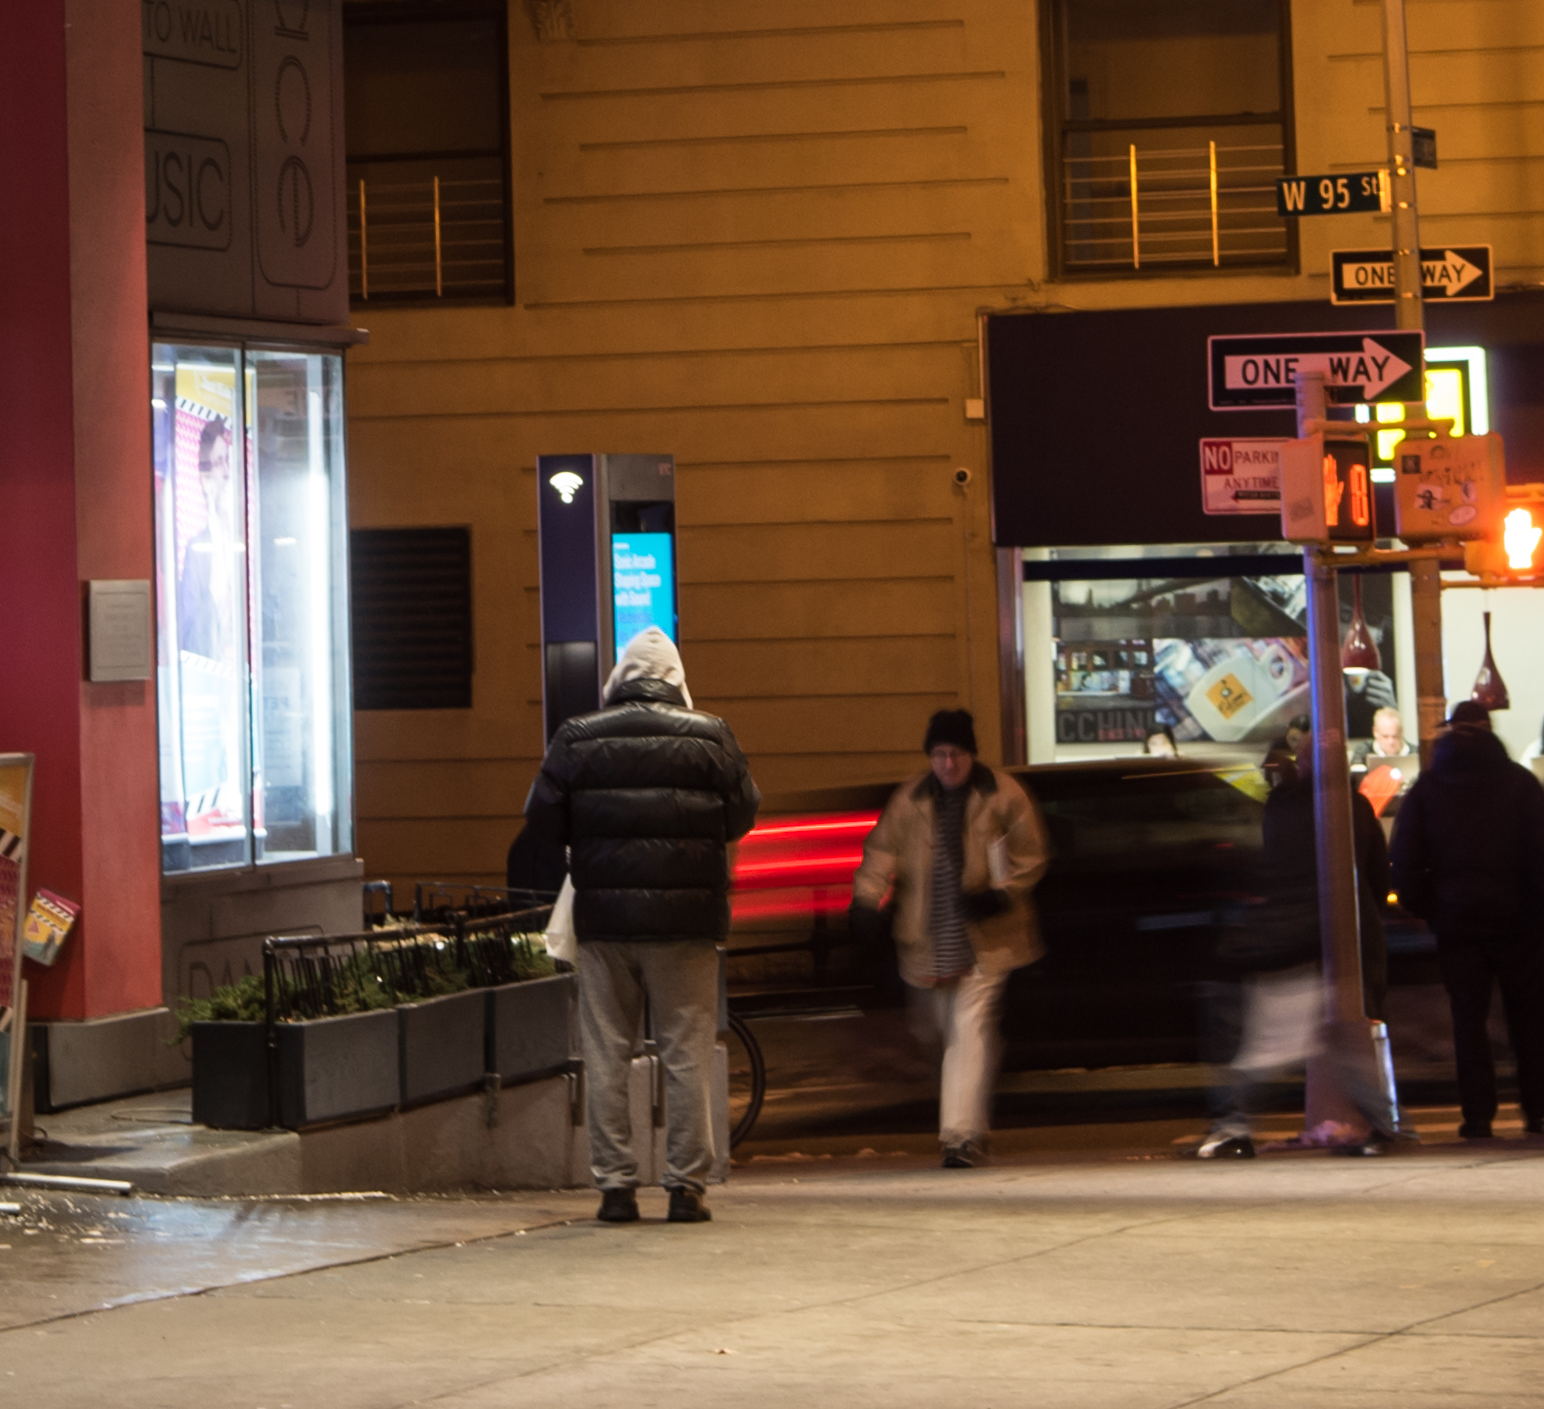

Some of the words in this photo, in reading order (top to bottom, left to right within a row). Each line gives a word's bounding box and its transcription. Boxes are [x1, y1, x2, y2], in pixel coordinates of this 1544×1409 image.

[179, 8, 238, 54] WALL
[145, 149, 225, 232] USIC
[1282, 181, 1305, 211] W
[1319, 178, 1350, 209] 95
[1361, 176, 1379, 196] St
[1354, 265, 1396, 286] ONE
[1421, 263, 1466, 284] WAY
[1242, 358, 1300, 385] ONE
[1329, 356, 1391, 383] WAY
[1205, 445, 1231, 472] NO
[1234, 450, 1280, 465] PARKI
[1224, 476, 1279, 490] ANYTIME
